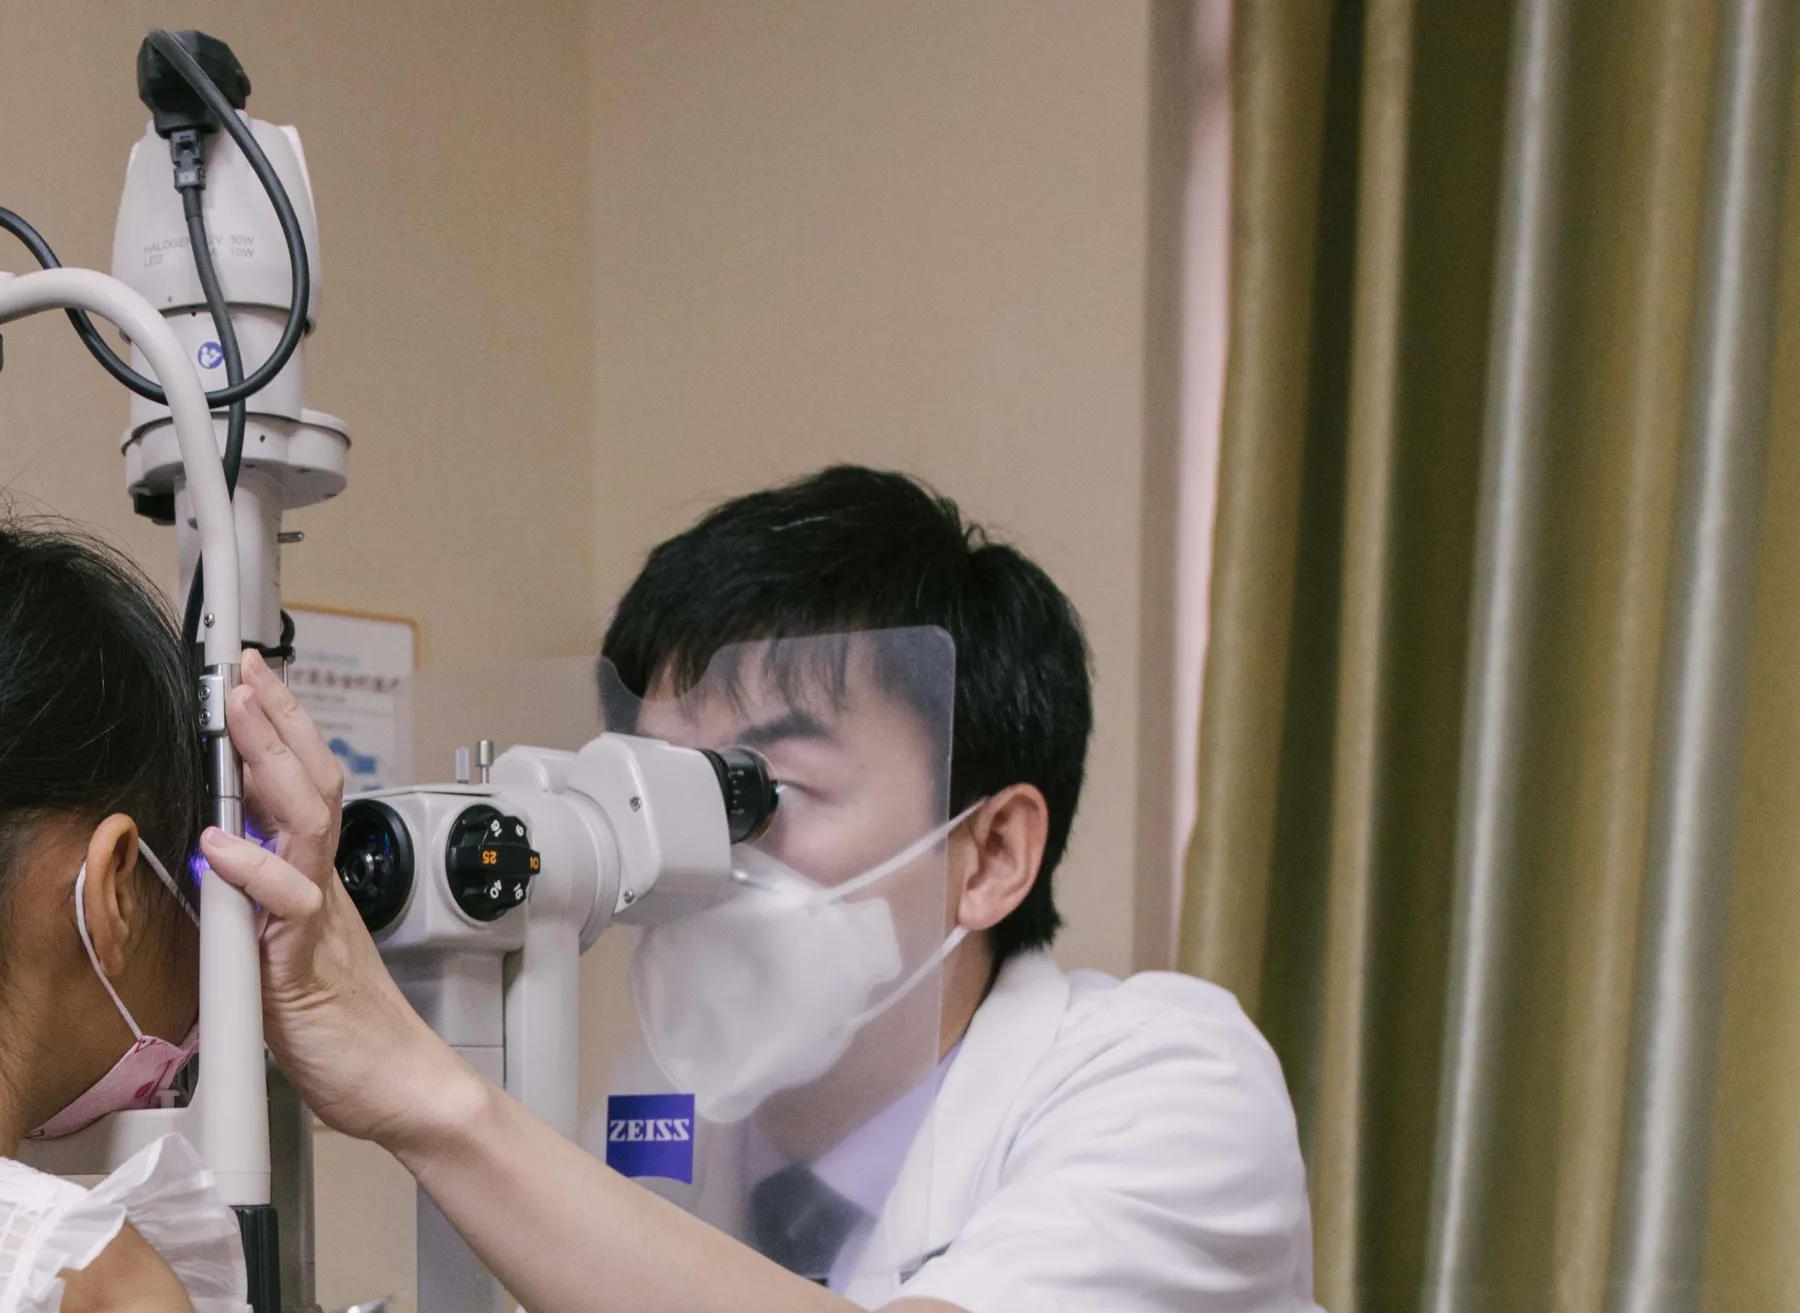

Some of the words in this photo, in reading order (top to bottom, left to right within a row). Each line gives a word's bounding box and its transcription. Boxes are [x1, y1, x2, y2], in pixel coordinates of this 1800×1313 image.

[143, 253, 163, 268] LED
[482, 850, 497, 864] 25
[530, 856, 539, 869] 10
[490, 880, 502, 899] 40
[609, 1118, 690, 1142] ZEISS
